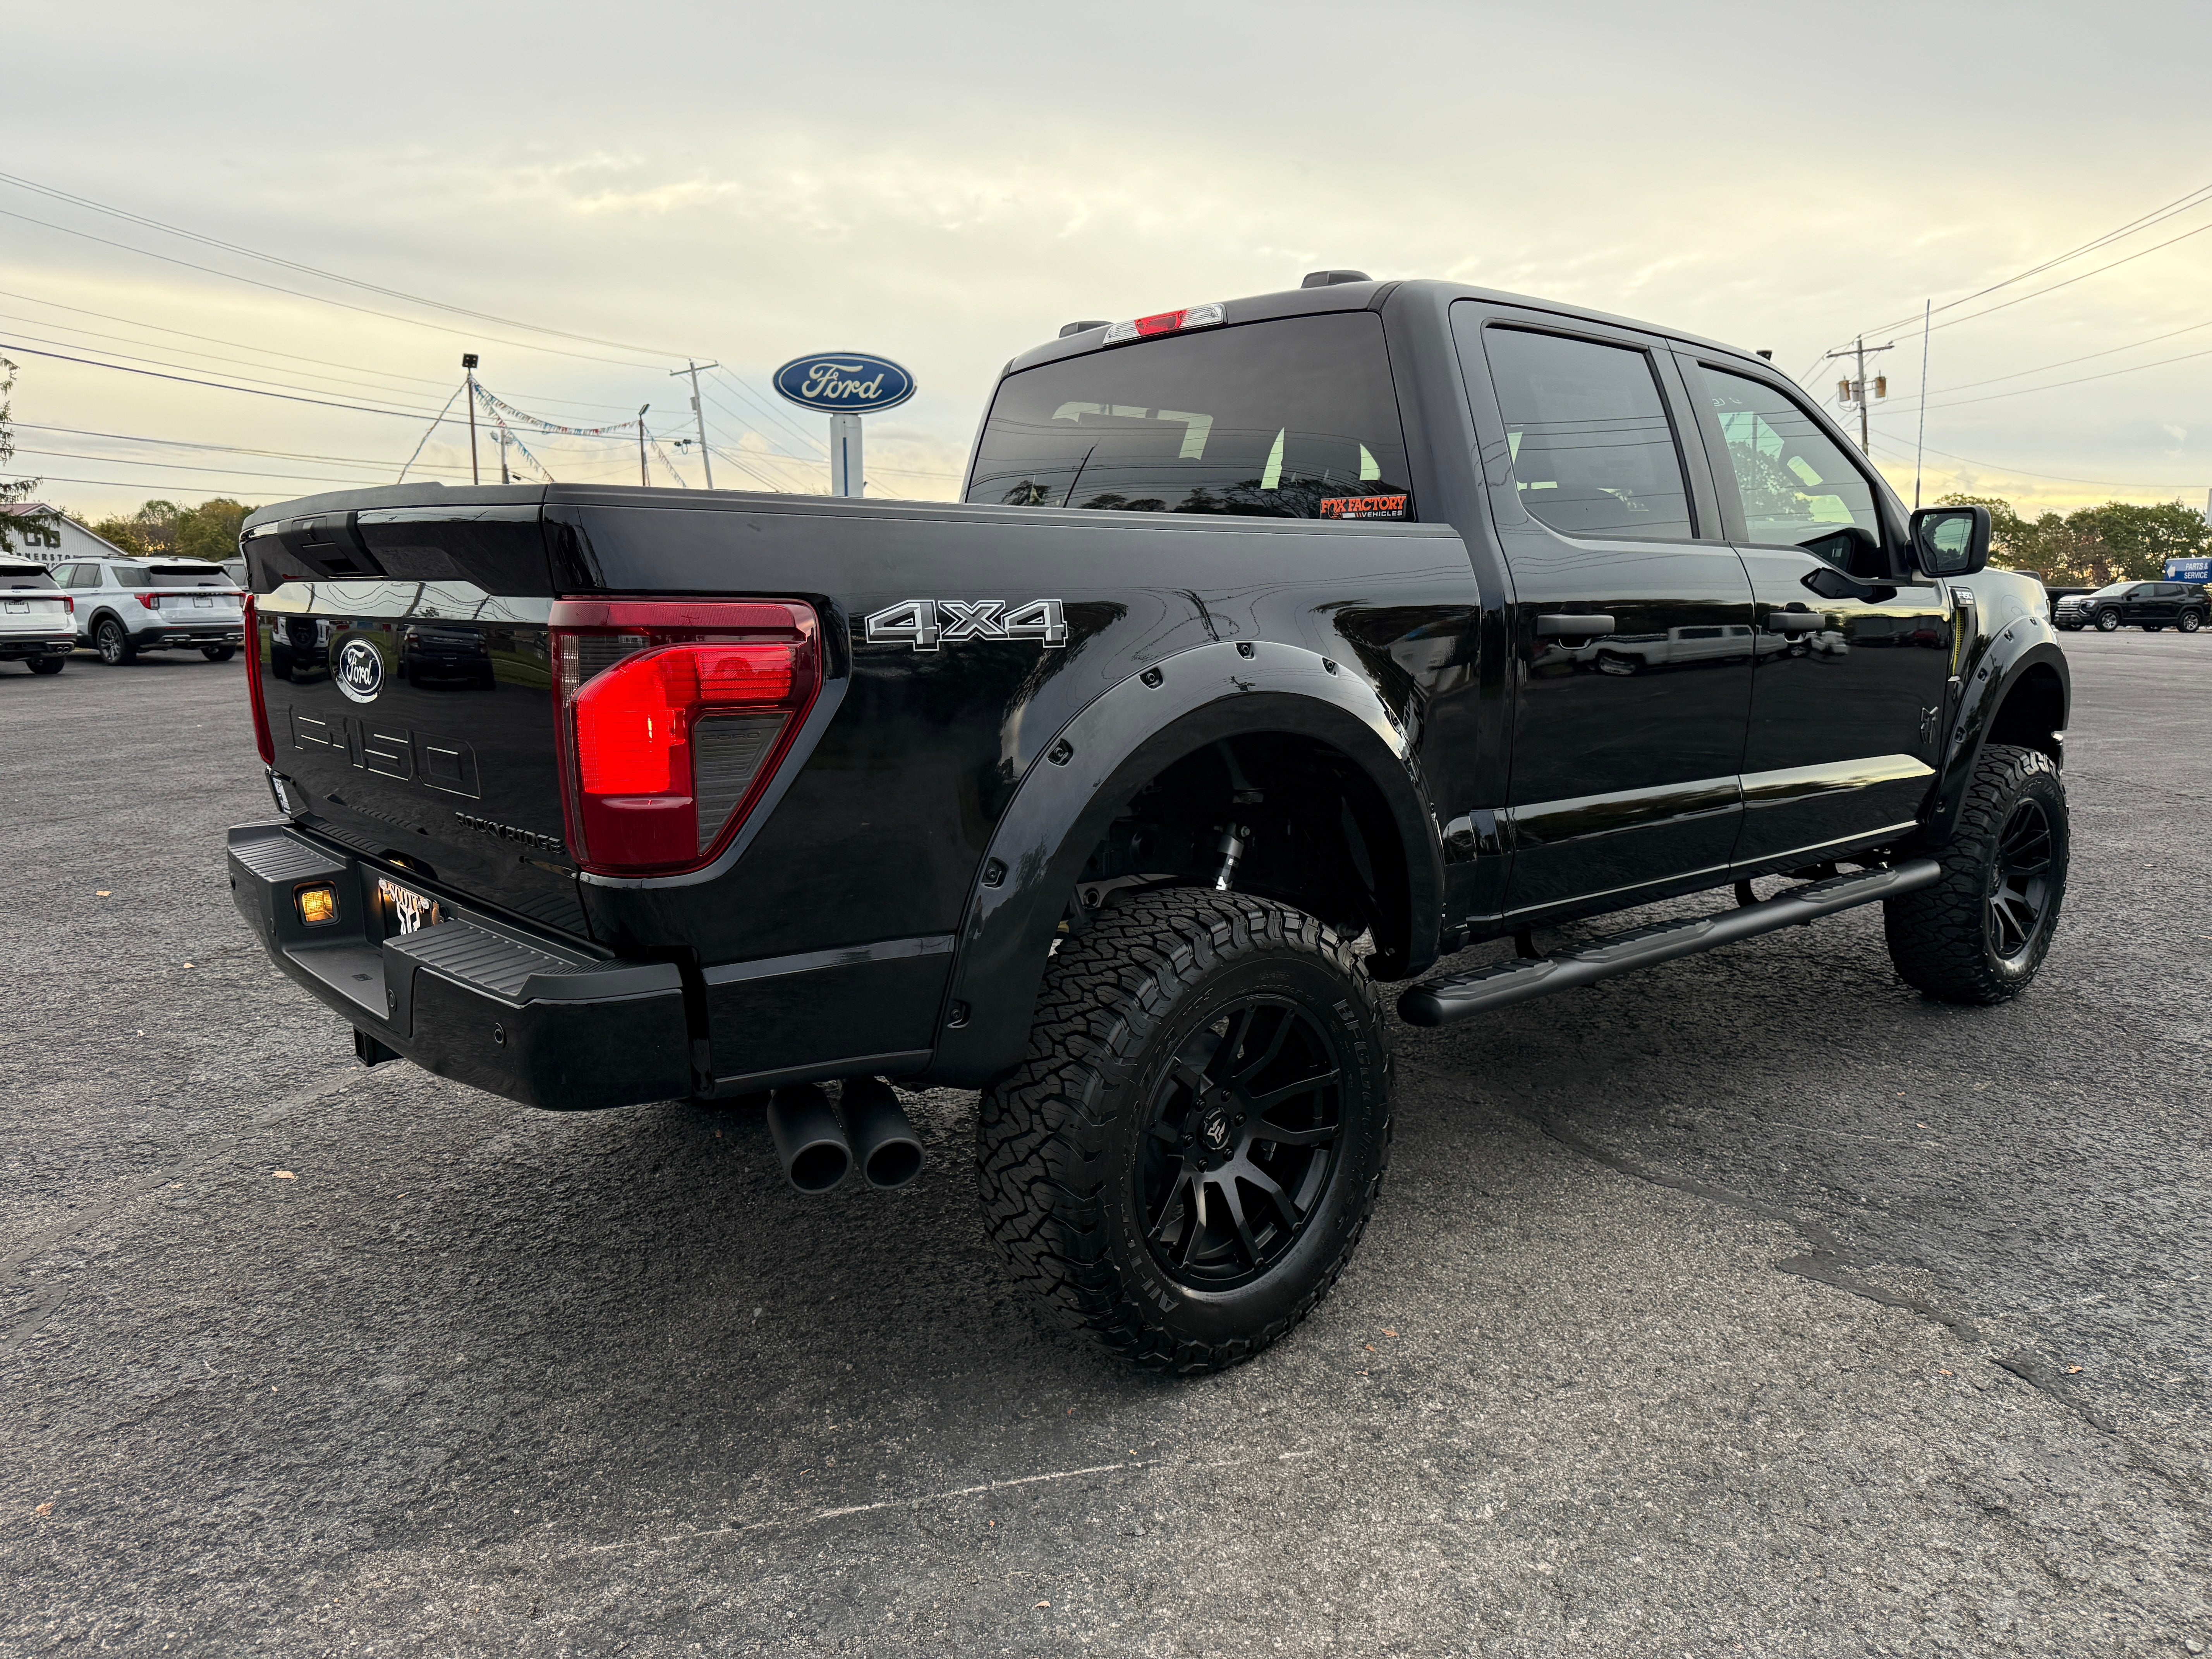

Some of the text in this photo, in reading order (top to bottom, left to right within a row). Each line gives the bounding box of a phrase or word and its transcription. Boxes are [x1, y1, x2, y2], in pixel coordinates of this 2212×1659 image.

[802, 363, 884, 399] Ford
[1321, 496, 1407, 514] FOX FACTORY
[2184, 571, 2209, 579] SERVICE
[2185, 562, 2203, 570] PARTS
[346, 648, 373, 685] Ford
[701, 733, 761, 742] FORD
[289, 704, 481, 799] F-150
